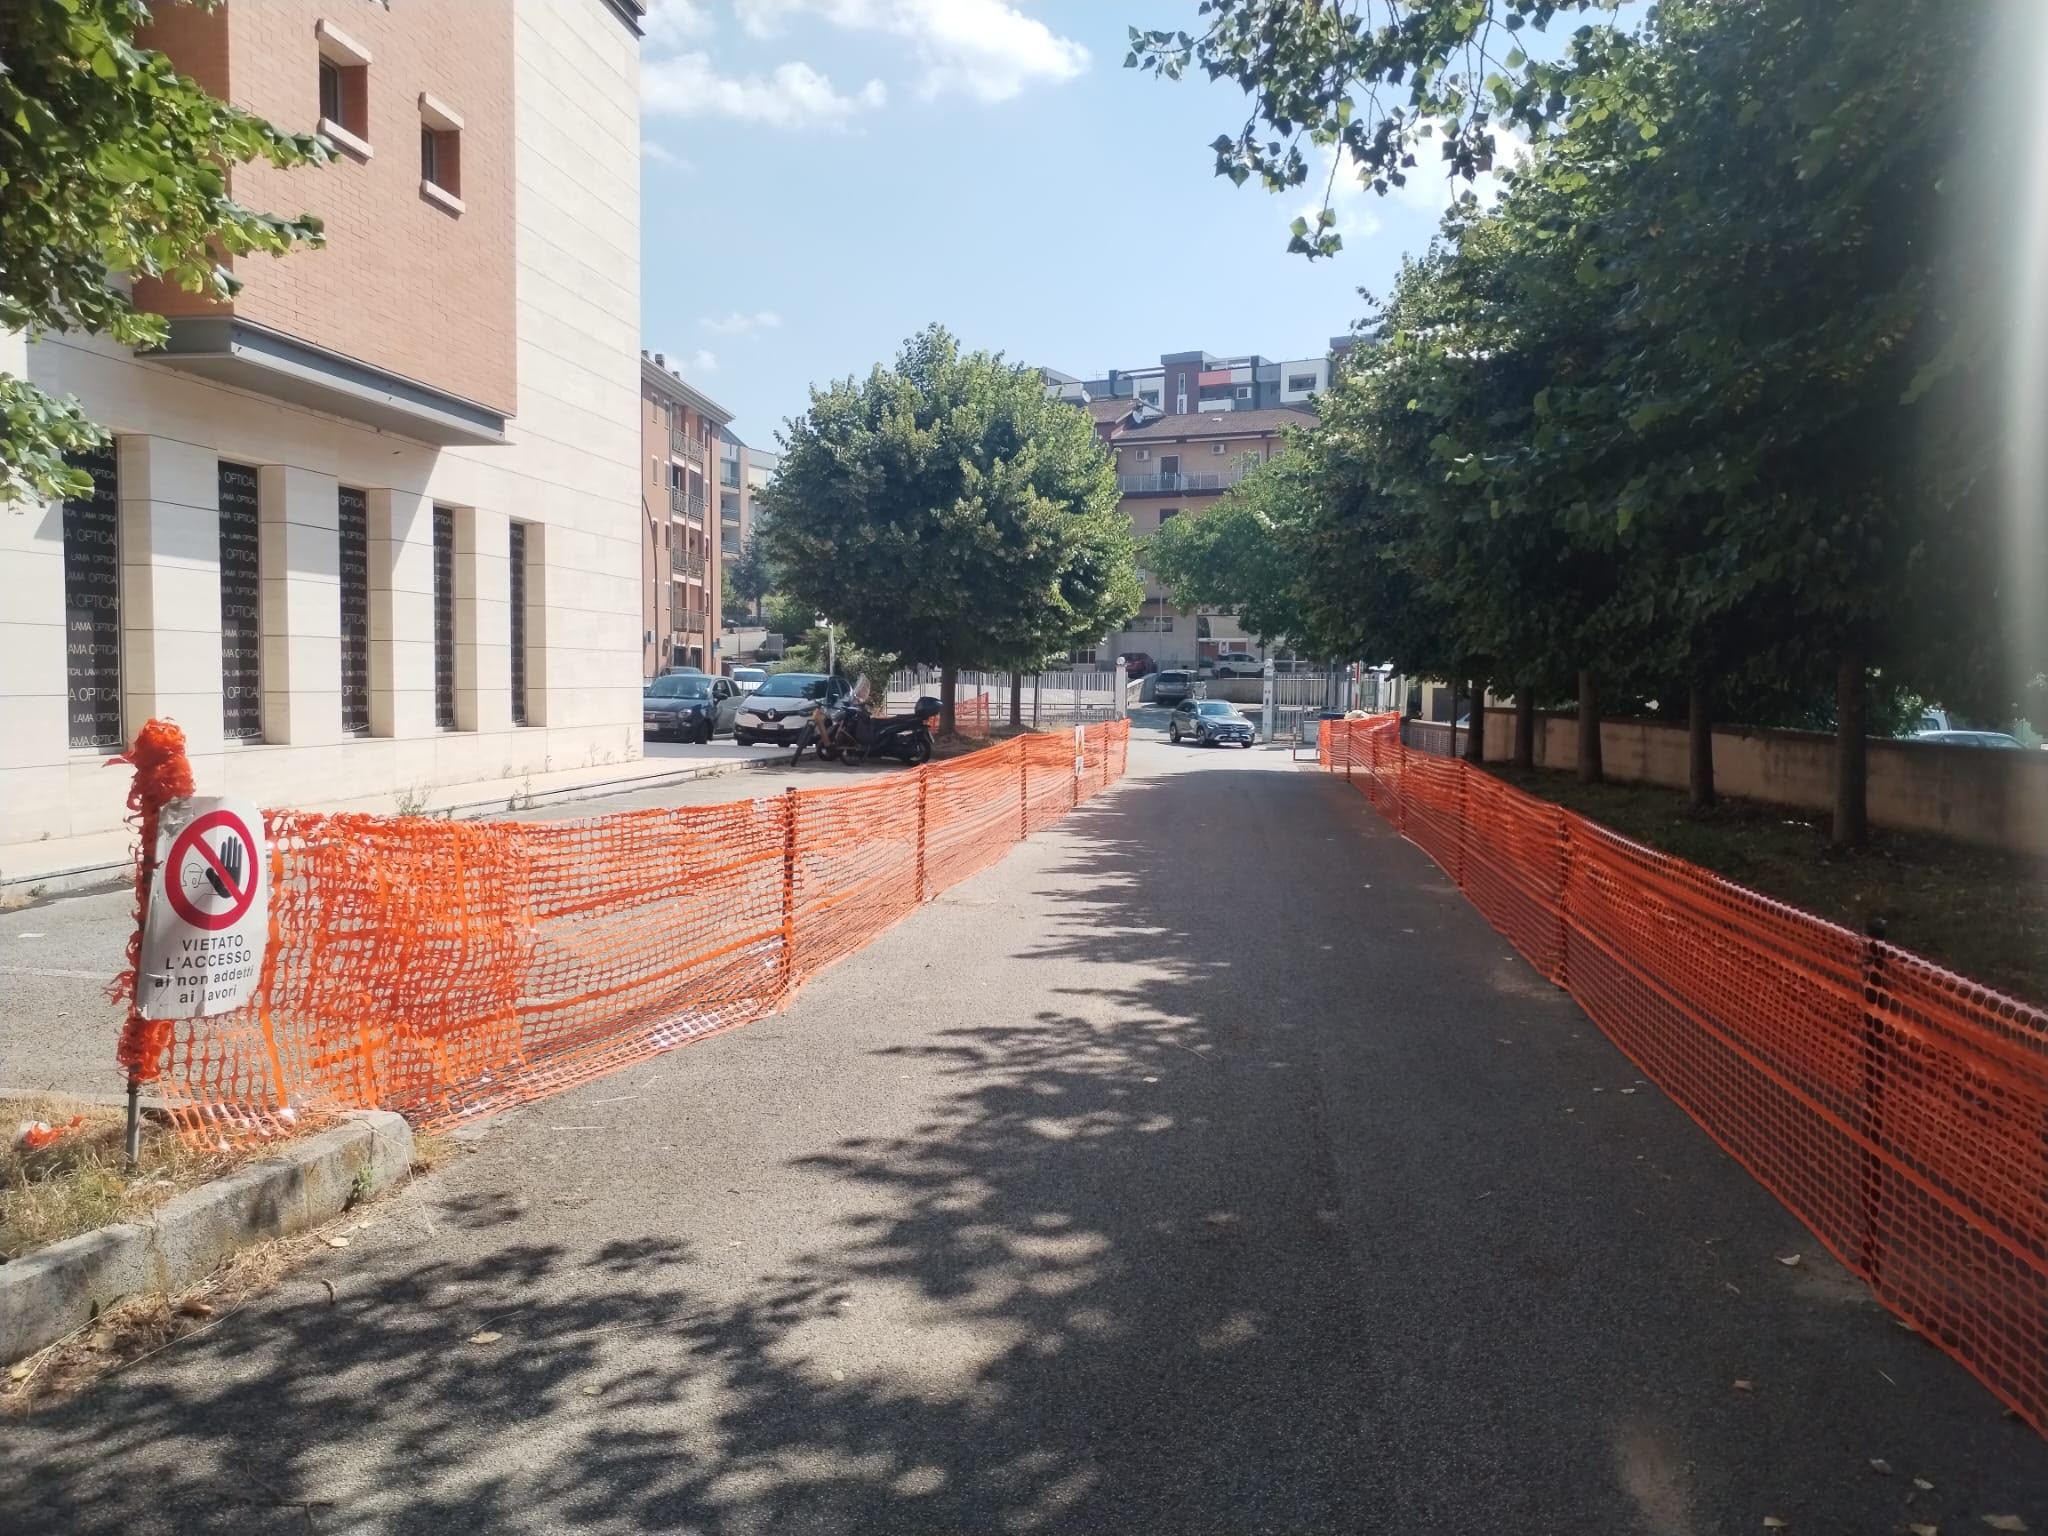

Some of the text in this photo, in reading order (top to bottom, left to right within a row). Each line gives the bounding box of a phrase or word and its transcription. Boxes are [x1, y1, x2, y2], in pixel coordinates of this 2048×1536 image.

[71, 621, 92, 631] LAMA
[73, 713, 95, 723] LAMA
[182, 934, 244, 951] VIETATO
[166, 950, 251, 970] L'ACCESSO
[155, 965, 253, 988] ai non addetti
[179, 985, 237, 1004] ai lavori
